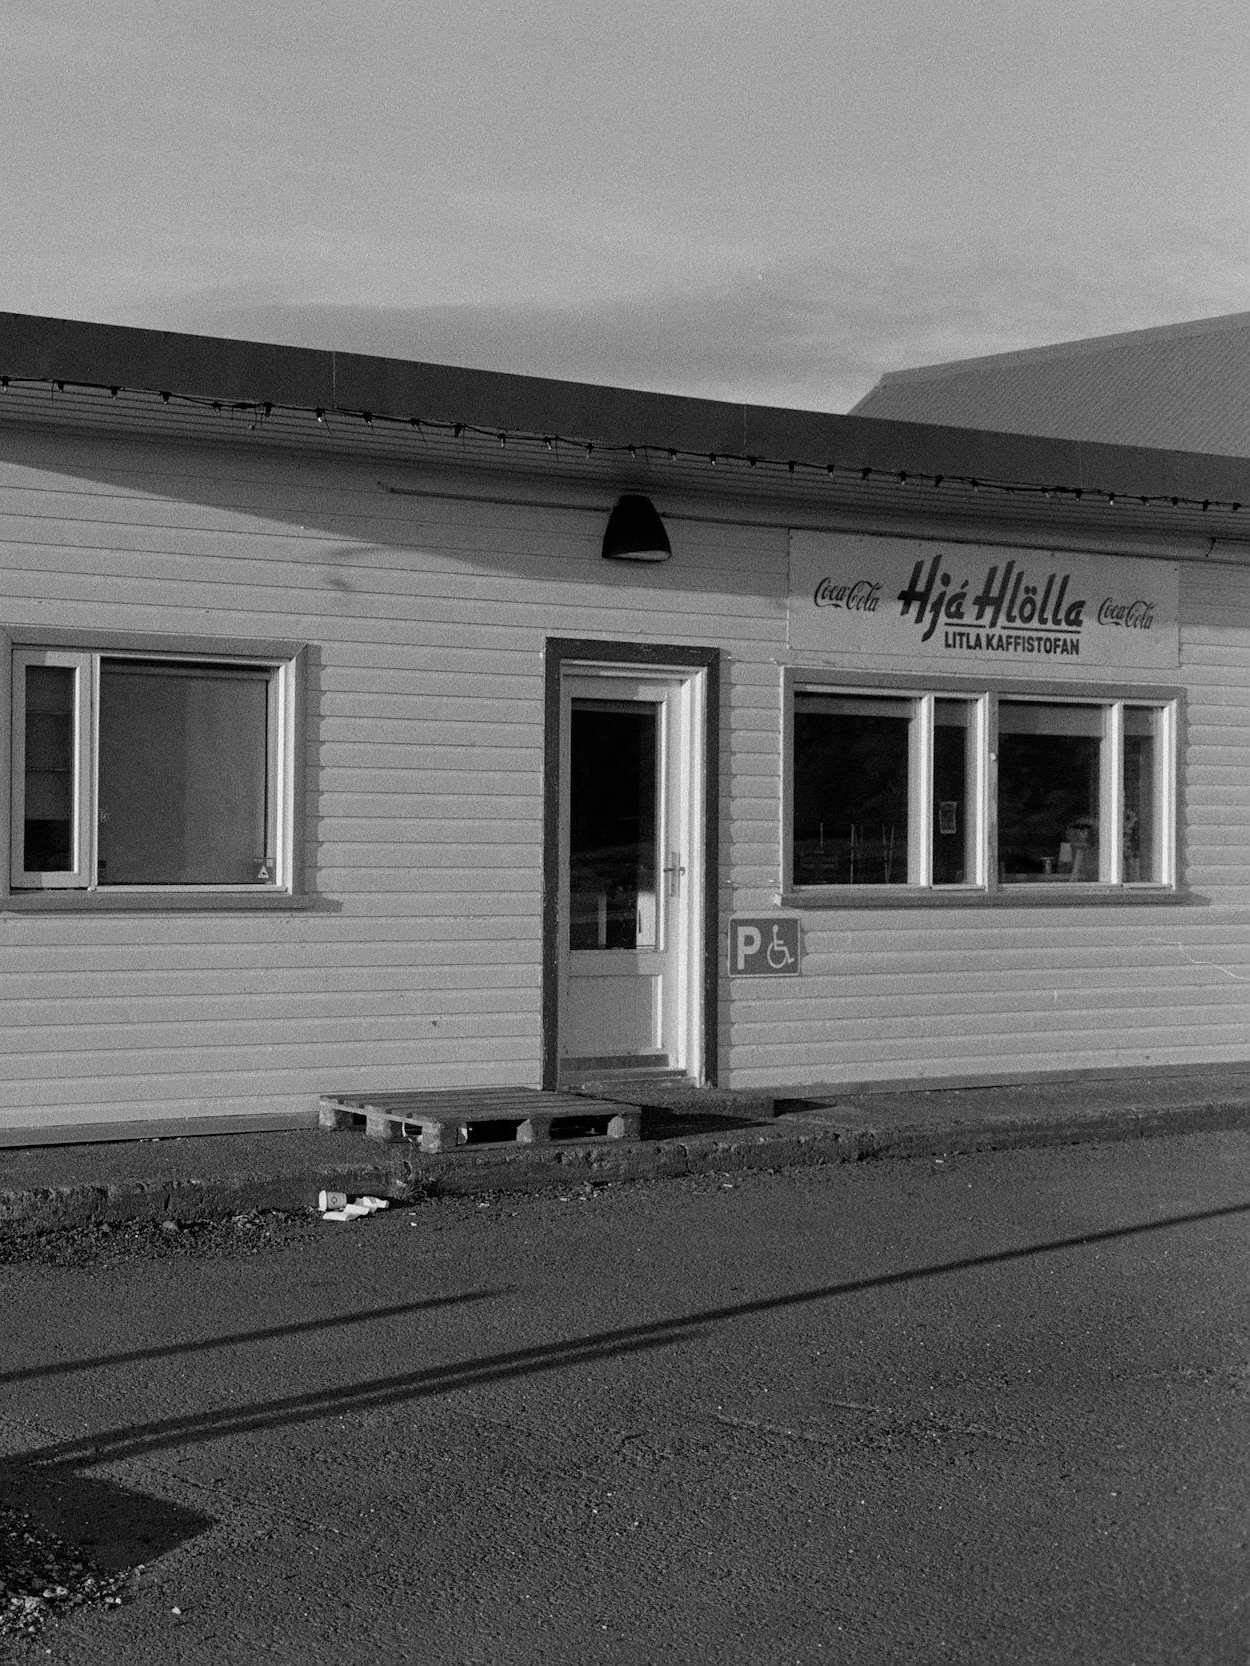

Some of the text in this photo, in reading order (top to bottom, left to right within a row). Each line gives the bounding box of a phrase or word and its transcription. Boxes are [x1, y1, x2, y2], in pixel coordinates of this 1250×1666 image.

[814, 577, 883, 613] Coca-Cola
[898, 554, 1085, 642] Hjá Hlölla
[1098, 597, 1157, 630] Coca-Cola
[944, 631, 1080, 655] LITLA KAFFISTOFAN
[737, 926, 761, 969] P
